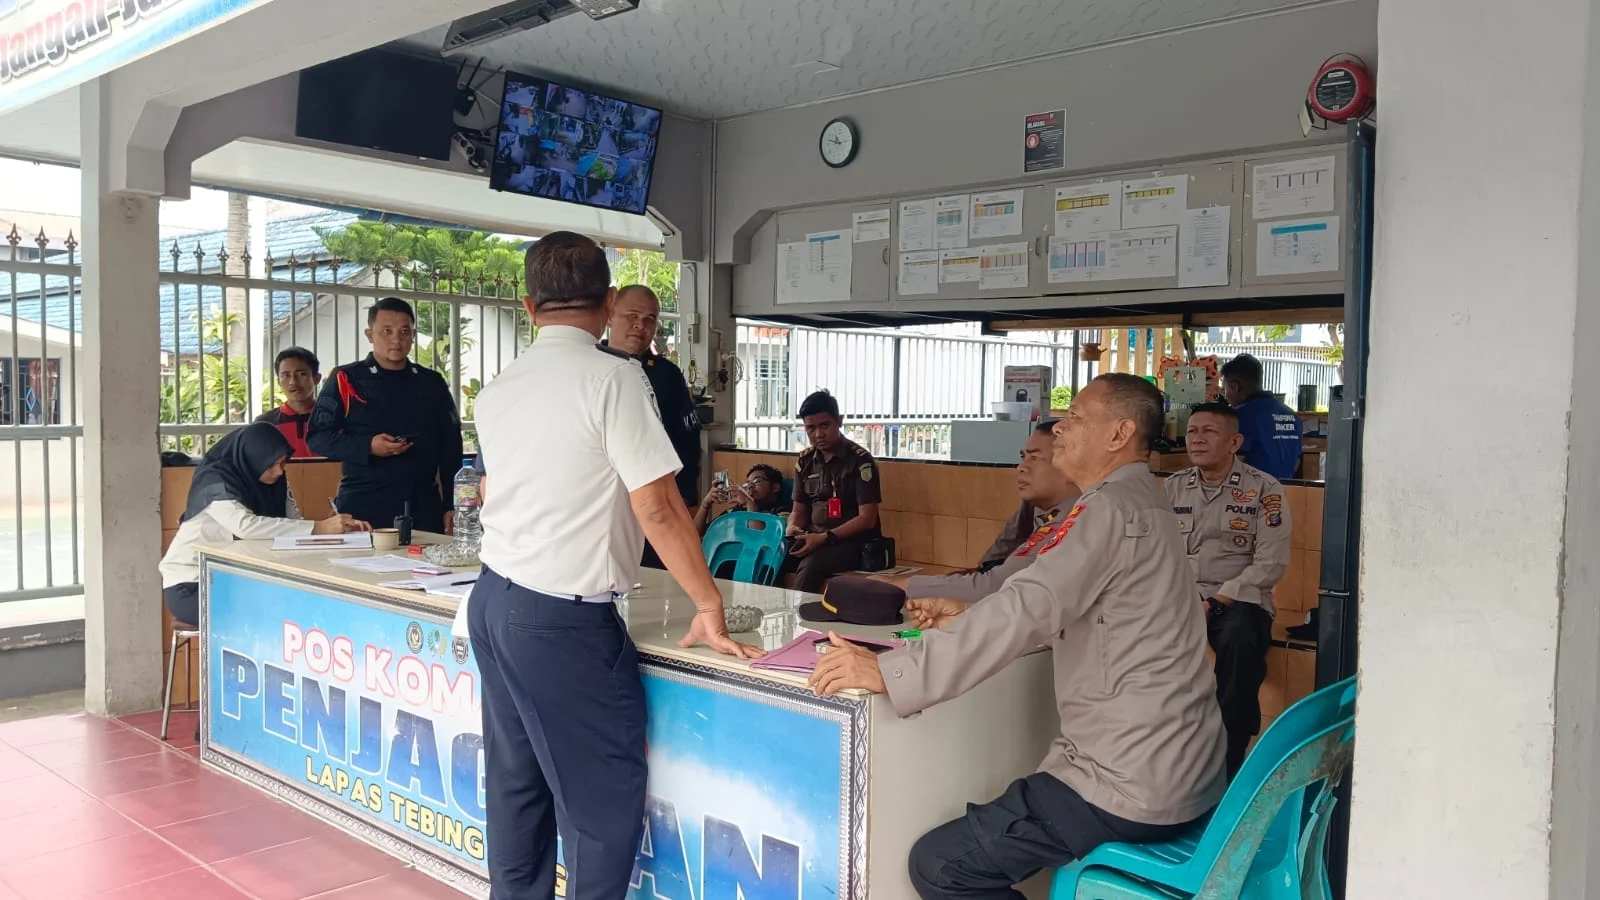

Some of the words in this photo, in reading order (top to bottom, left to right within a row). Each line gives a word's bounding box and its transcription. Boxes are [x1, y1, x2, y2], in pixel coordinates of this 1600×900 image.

[1226, 504, 1257, 515] POLRI
[282, 620, 354, 683] POS
[365, 644, 482, 714] KOM
[306, 755, 383, 813] LAPAS
[390, 791, 485, 860] TEBING
